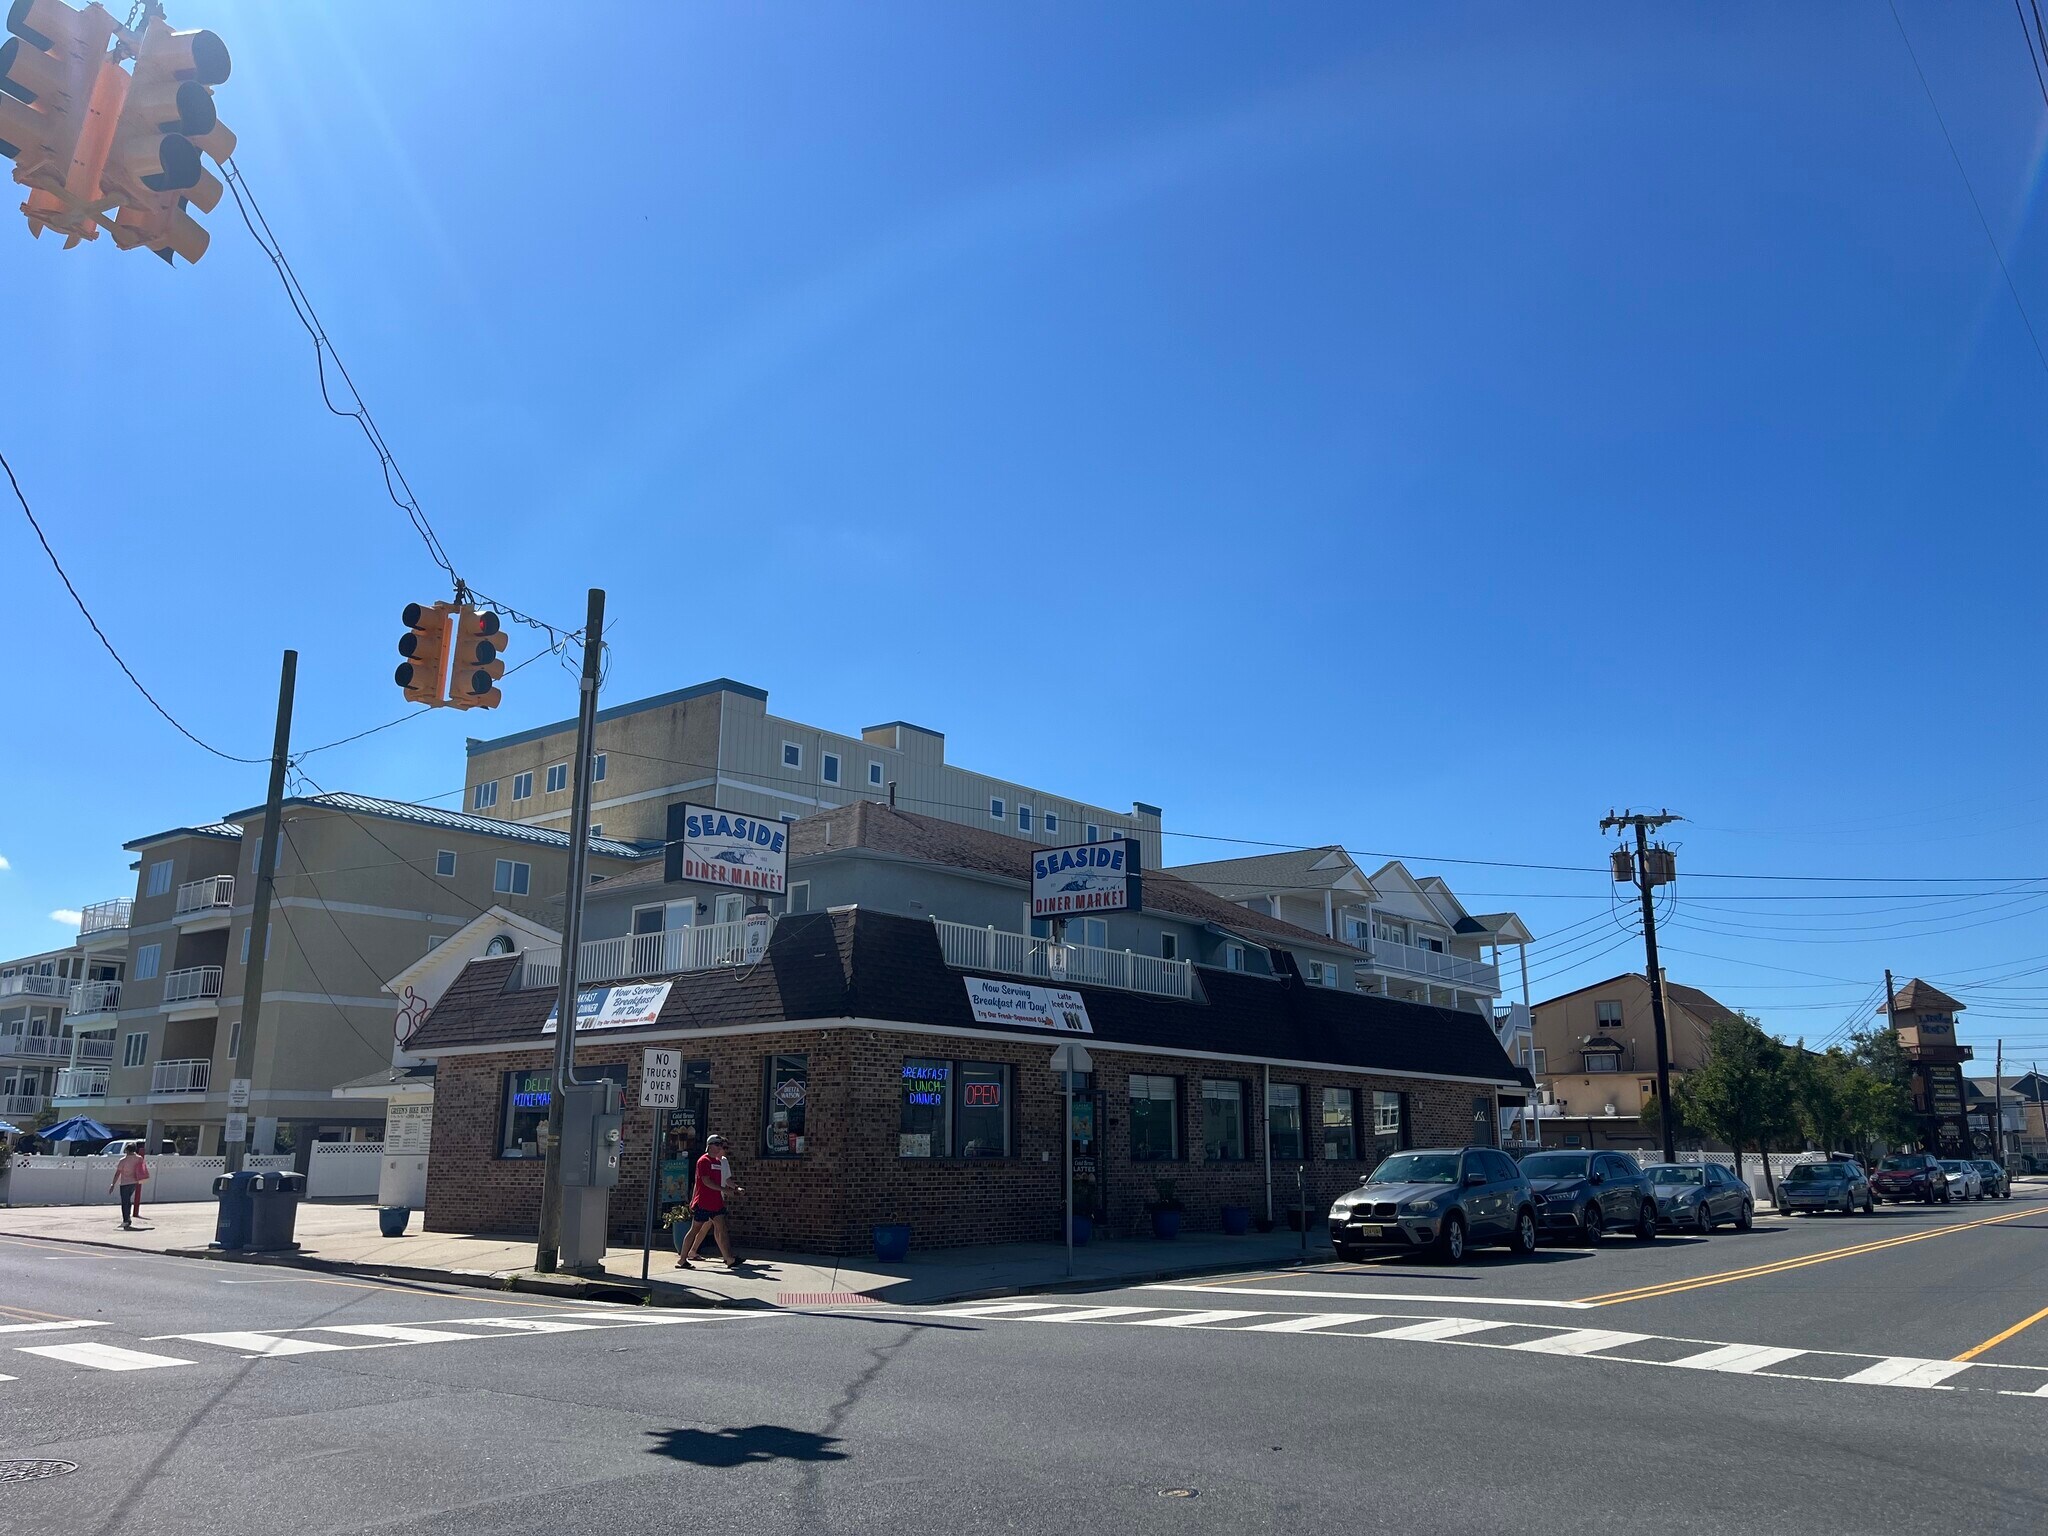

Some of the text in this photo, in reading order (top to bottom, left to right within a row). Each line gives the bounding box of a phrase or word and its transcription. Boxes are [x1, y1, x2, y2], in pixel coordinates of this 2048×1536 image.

[686, 814, 785, 854] SEASIDE
[1035, 847, 1124, 879] SEASIDE
[686, 859, 783, 891] DINER MARKET
[1036, 890, 1124, 913] DINER MARKET
[612, 986, 664, 997] Now Serving
[982, 982, 1031, 999] Now Serving
[1057, 992, 1072, 1001] Latte
[613, 995, 656, 1007] Breakfast
[972, 994, 1047, 1014] Breakfast All Day!
[1051, 1000, 1083, 1011] Iced Coffee
[611, 1005, 649, 1016] All Day!
[656, 1053, 669, 1066] NO
[646, 1067, 677, 1079] TRUCKS
[902, 1066, 949, 1080] BREAKFAST
[525, 1078, 550, 1092] DELI
[651, 1080, 671, 1091] OVER
[644, 1093, 675, 1104] 4 TONS
[909, 1092, 942, 1105] DINNER
[966, 1085, 999, 1105] OPEN
